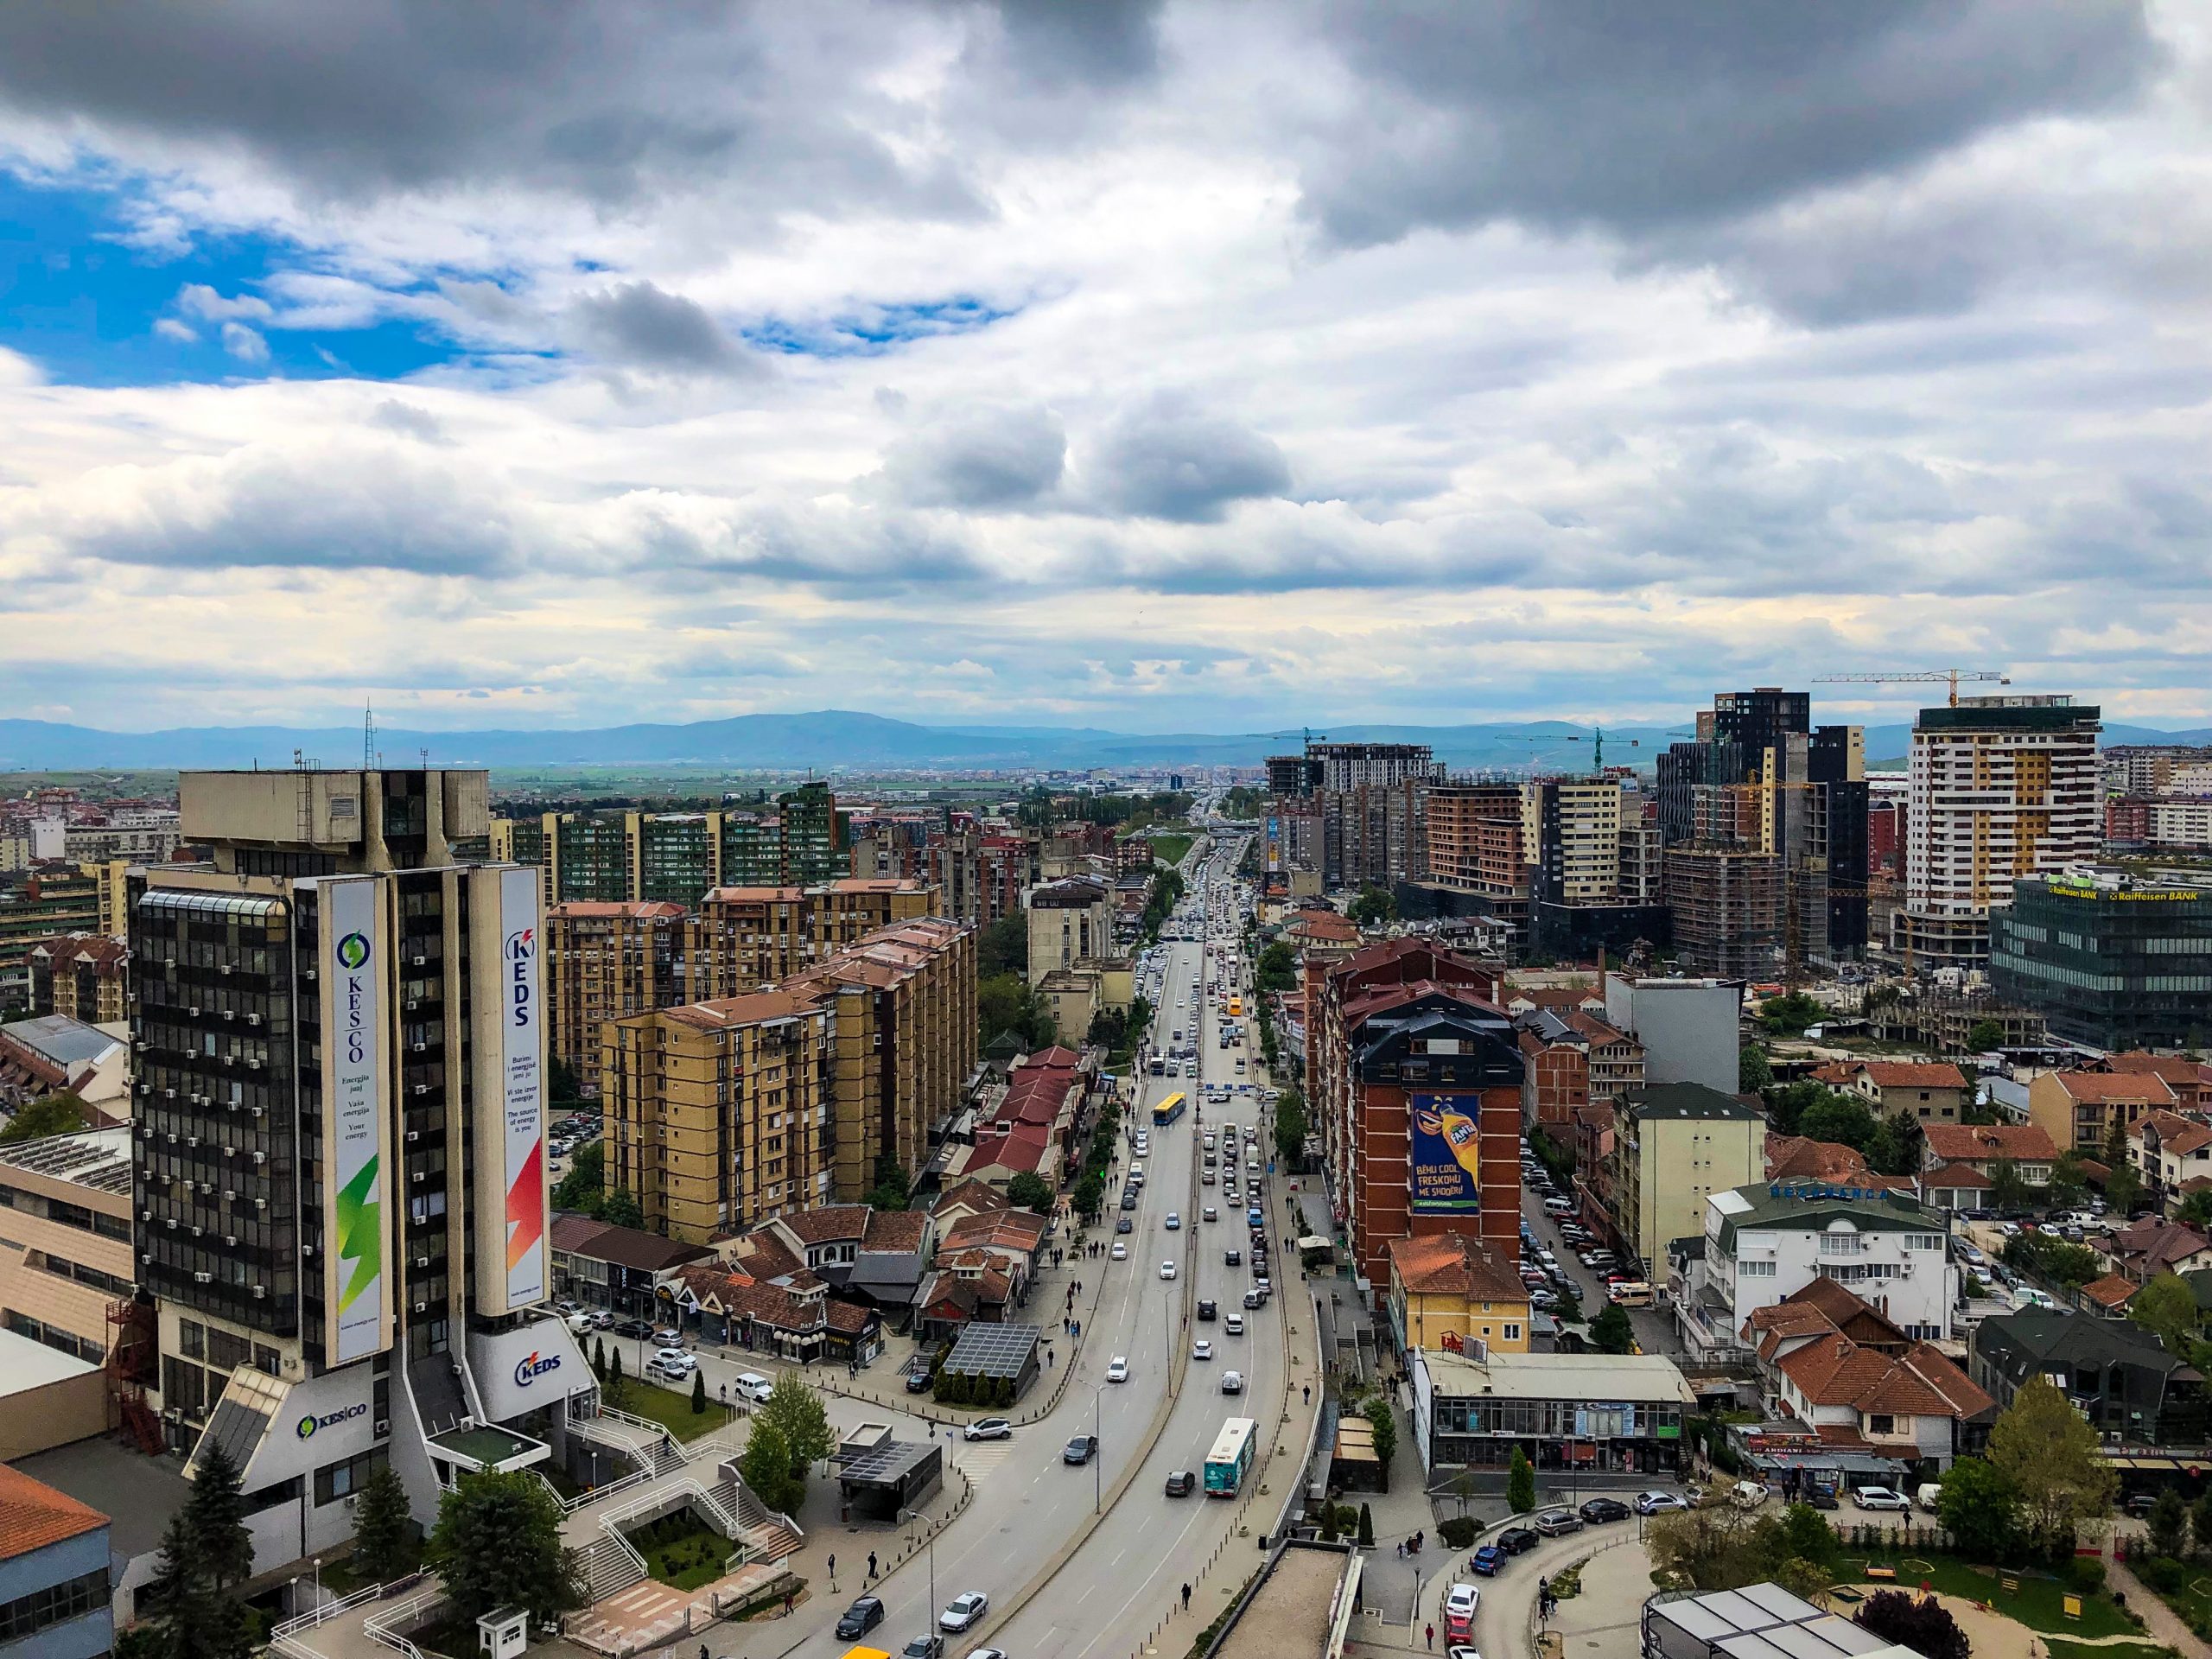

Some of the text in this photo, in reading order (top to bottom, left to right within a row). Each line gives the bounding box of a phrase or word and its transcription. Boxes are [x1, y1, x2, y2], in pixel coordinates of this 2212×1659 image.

[2053, 887, 2097, 899] Raiffeisen BANK
[2119, 892, 2197, 901] Raiffeisen BANK
[512, 935, 531, 1027] KEDS
[512, 1055, 531, 1064] Burimi
[342, 1107, 370, 1117] energija
[519, 1108, 538, 1116] source
[517, 1116, 536, 1124] energy
[521, 1124, 531, 1133] you
[346, 1131, 368, 1140] energy
[1451, 1124, 1477, 1144] FANTA
[1418, 1174, 1461, 1186] FRESKOHU
[1419, 1187, 1430, 1197] ME
[520, 1353, 561, 1381] KEDS
